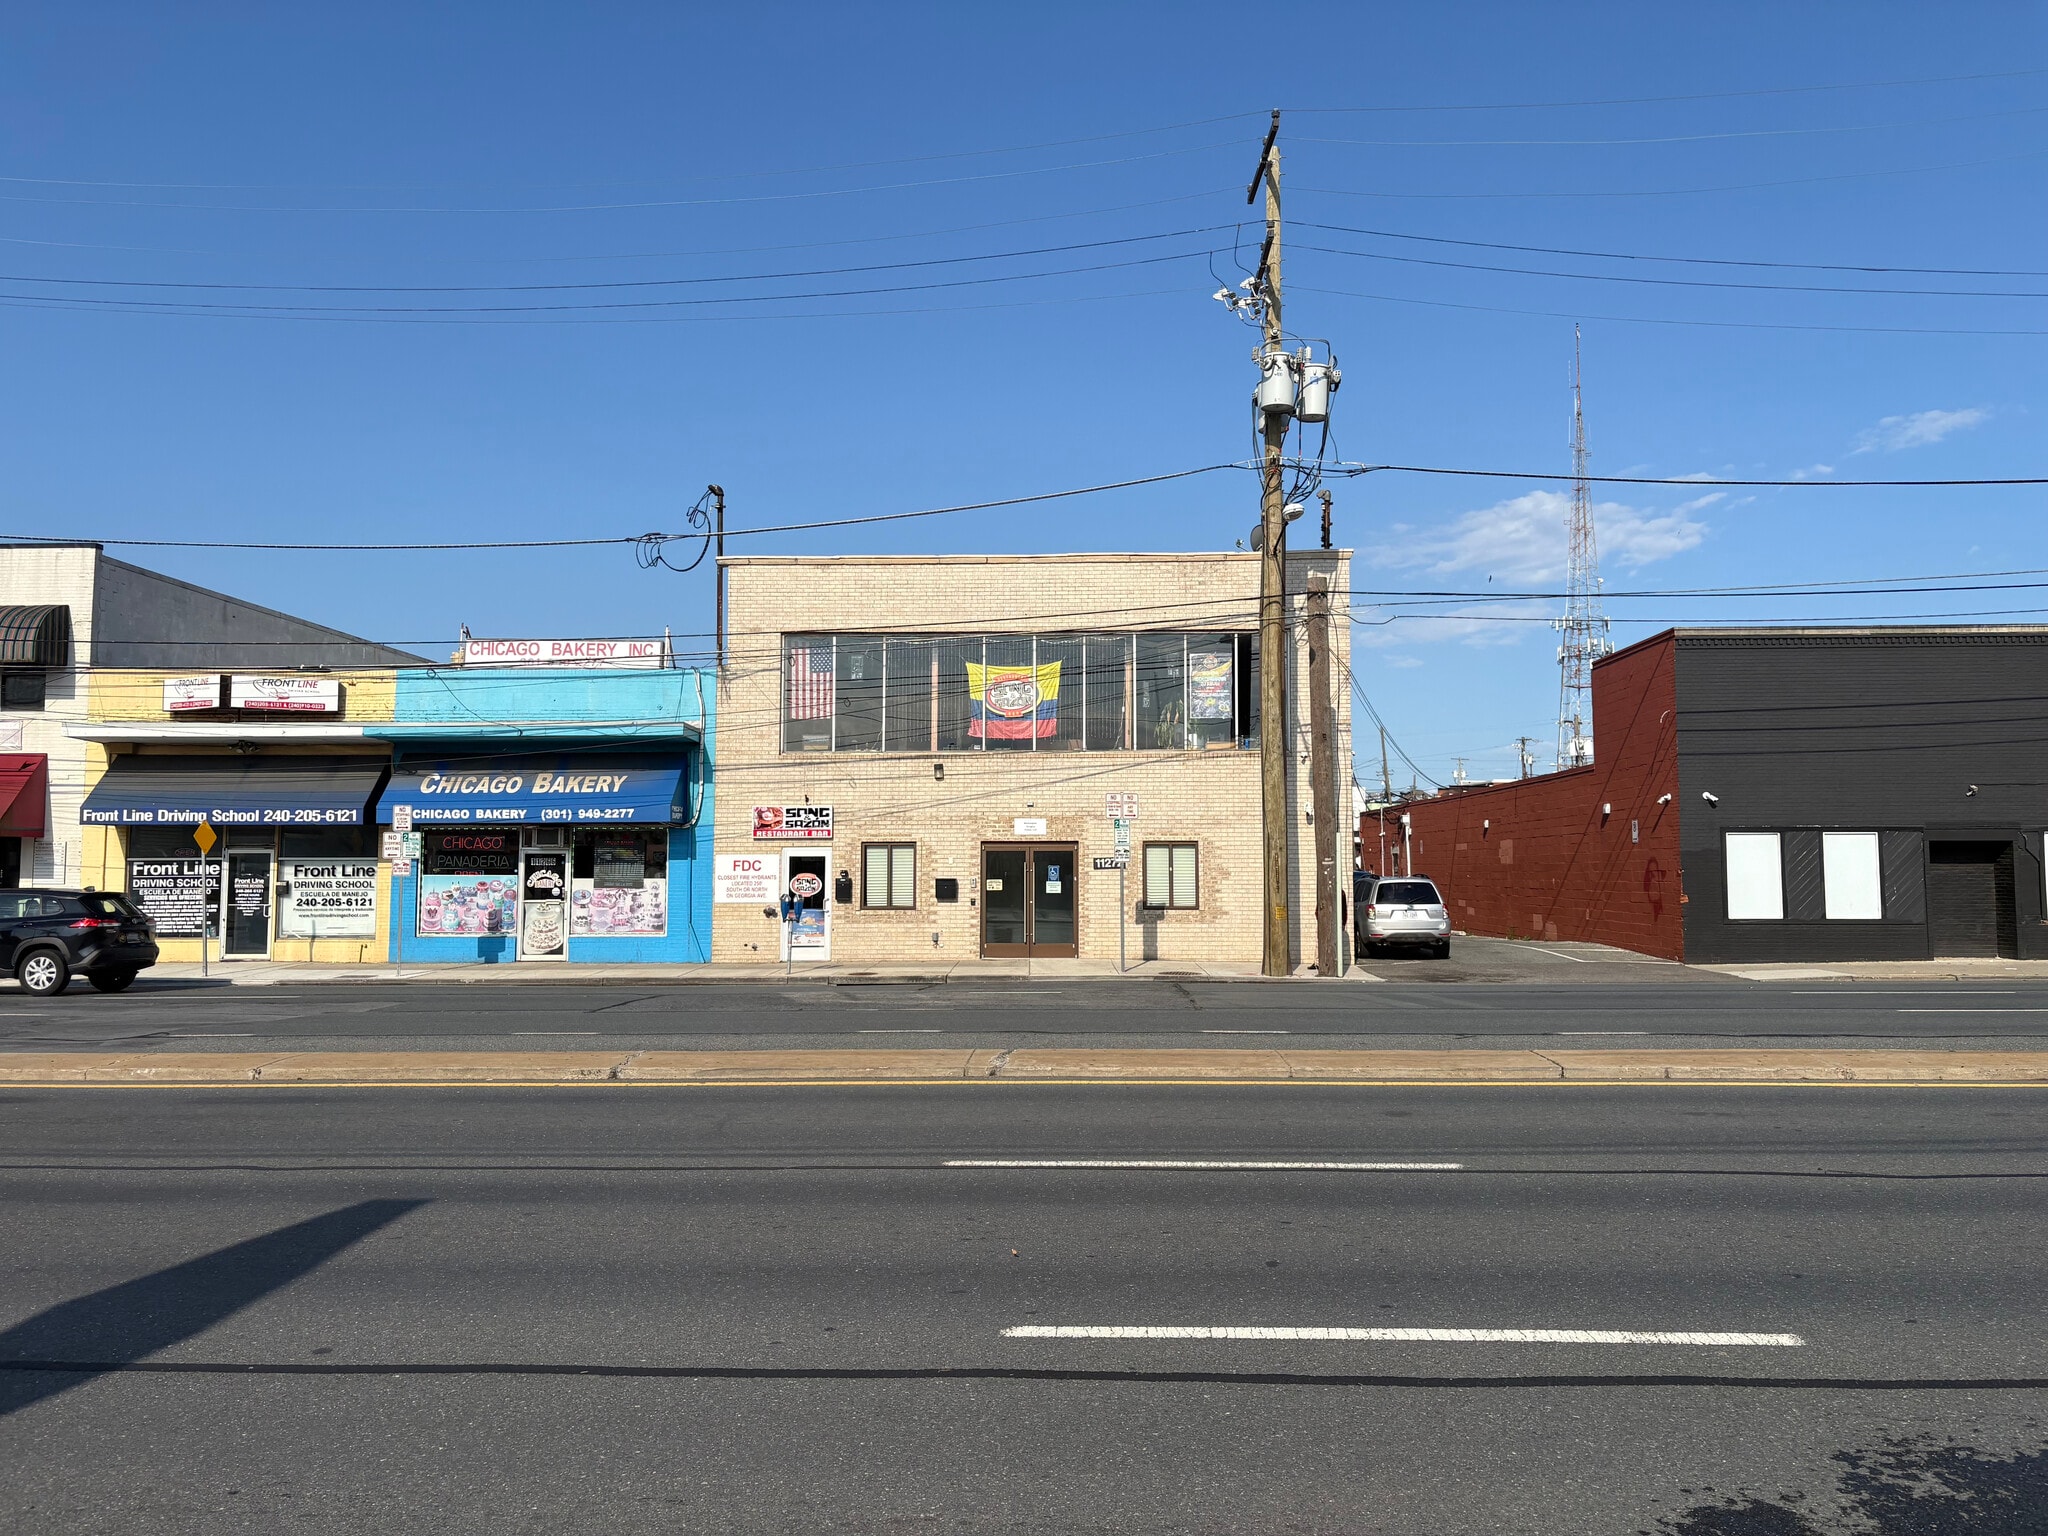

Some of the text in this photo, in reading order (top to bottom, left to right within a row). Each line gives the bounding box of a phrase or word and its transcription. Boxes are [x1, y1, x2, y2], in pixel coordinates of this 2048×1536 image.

[469, 642, 654, 657] CHICAGO BAKERY INC
[179, 678, 209, 687] FRONT LINE
[262, 678, 319, 688] FRONT LINE
[420, 773, 629, 794] CHICAGO BAKERY
[83, 809, 357, 824] Front Line Driving School 240-205-6121
[412, 808, 635, 821] CHICAGO BAKERY (301) 949-2277
[785, 808, 830, 818] SONG
[785, 818, 830, 829] SAZÓN
[1114, 819, 1120, 828] 2
[443, 836, 503, 850] CHICAGO
[437, 855, 510, 868] PANADERIA
[733, 860, 762, 871] FDC
[133, 862, 179, 876] Front
[294, 864, 376, 877] Front Line
[133, 879, 174, 888] DRIVING
[294, 881, 375, 889] DRIVING SCHOOL
[296, 898, 373, 907] 240-205-6121
